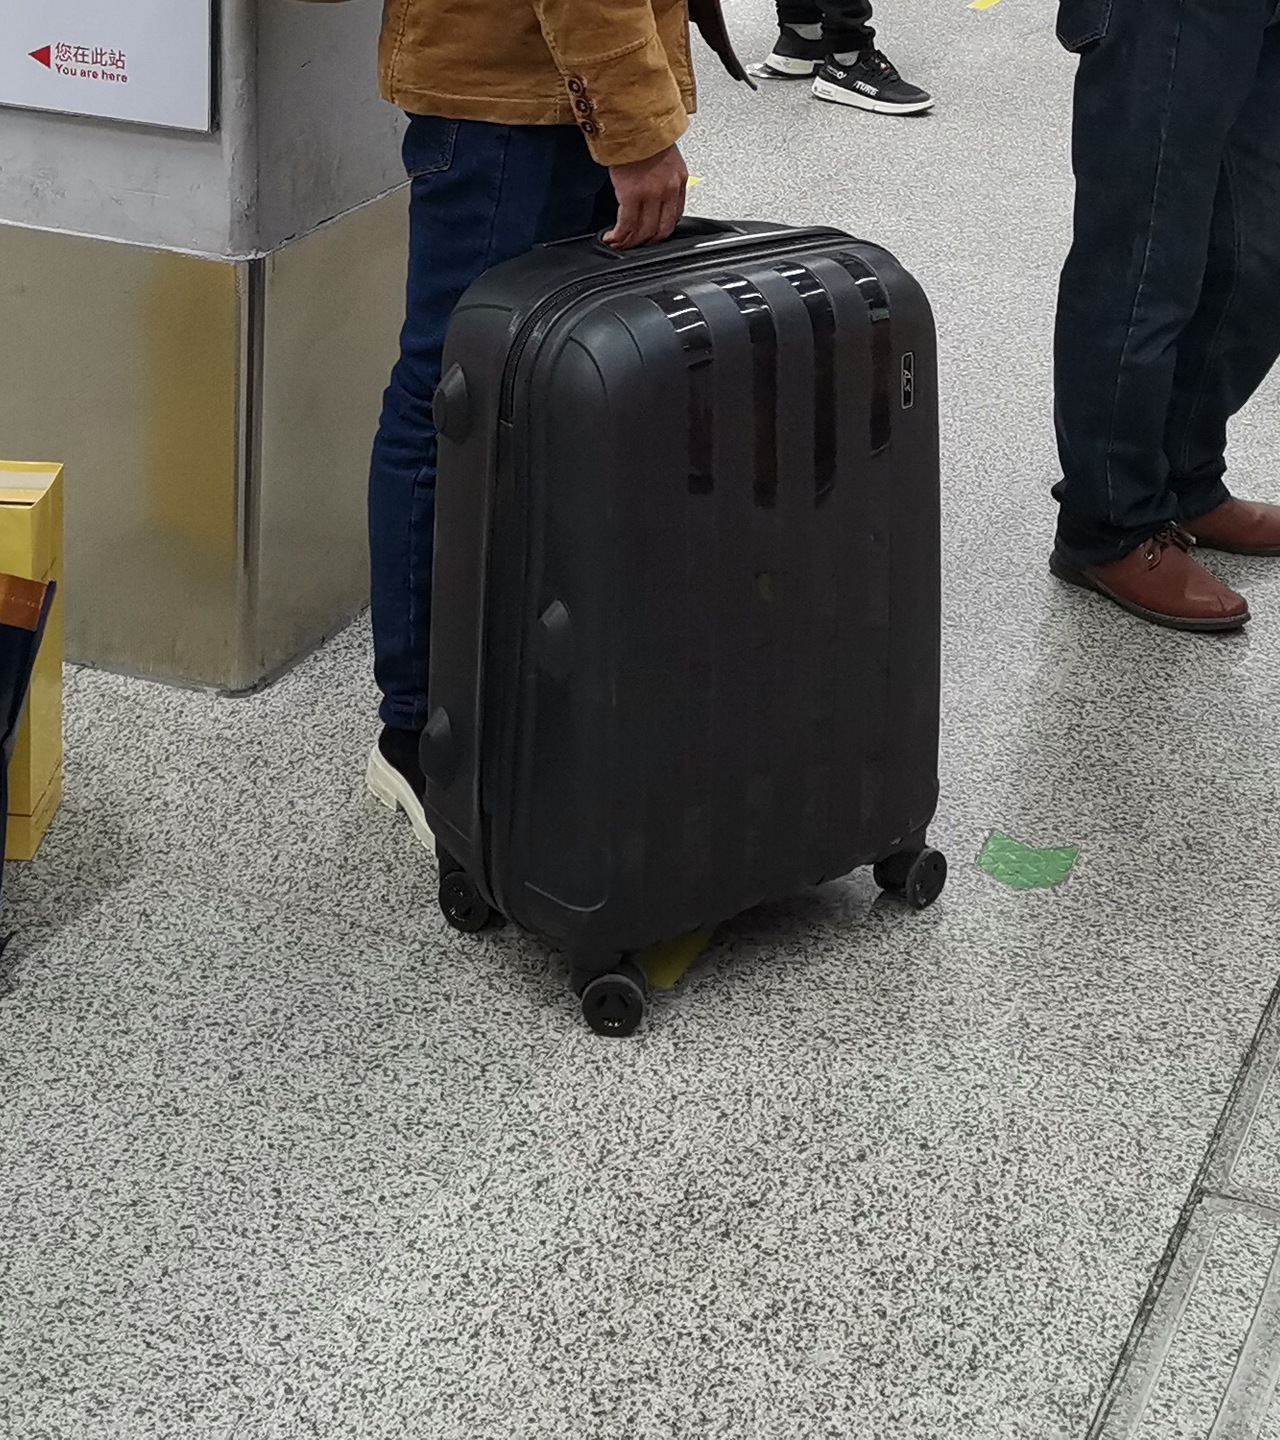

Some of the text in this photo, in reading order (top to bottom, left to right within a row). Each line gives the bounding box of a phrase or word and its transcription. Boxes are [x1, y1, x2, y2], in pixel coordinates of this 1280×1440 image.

[55, 42, 125, 70] 您在此站
[55, 63, 77, 77] You
[80, 67, 98, 80] are
